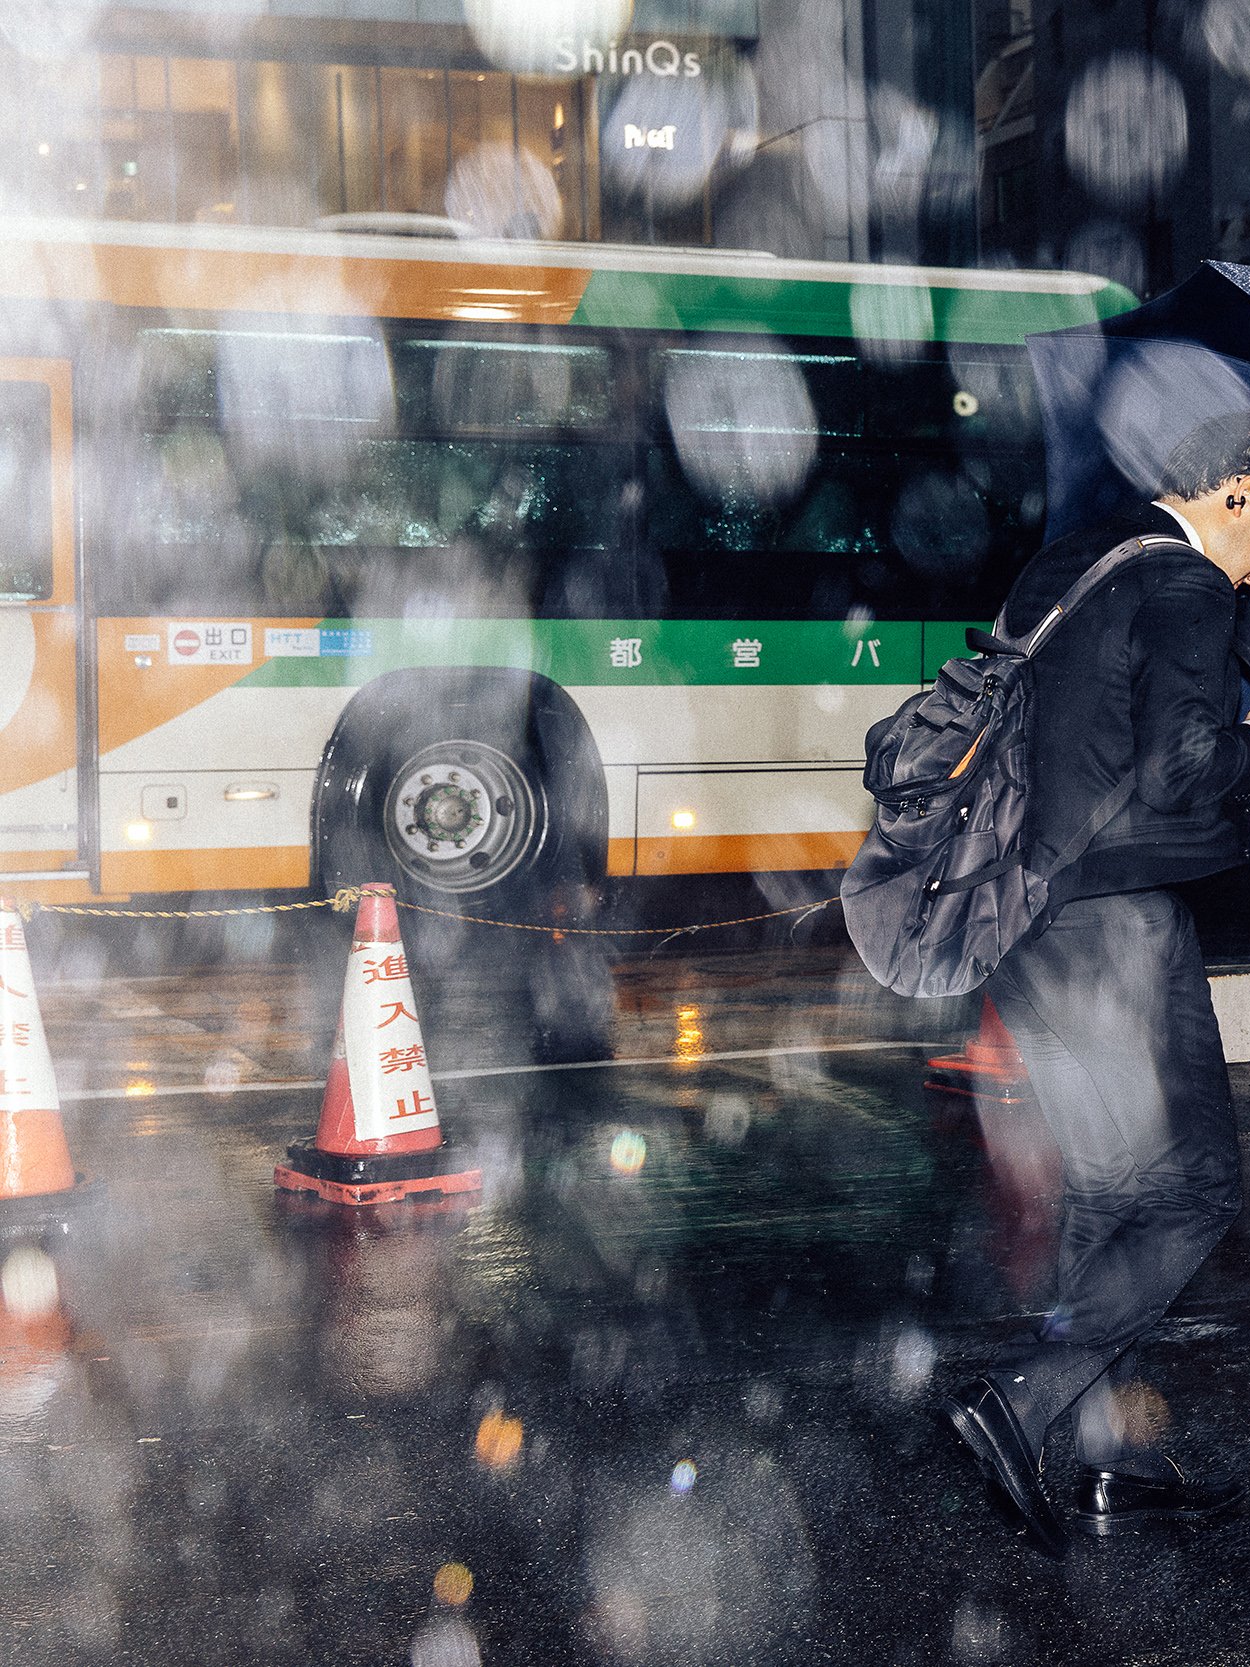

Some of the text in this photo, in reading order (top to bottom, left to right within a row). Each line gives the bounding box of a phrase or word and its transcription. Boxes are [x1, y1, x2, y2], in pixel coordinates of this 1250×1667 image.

[554, 40, 701, 77] ShinQs
[205, 628, 247, 646] 出口
[209, 650, 242, 660] EXIT
[363, 954, 434, 1120] 進入禁止
